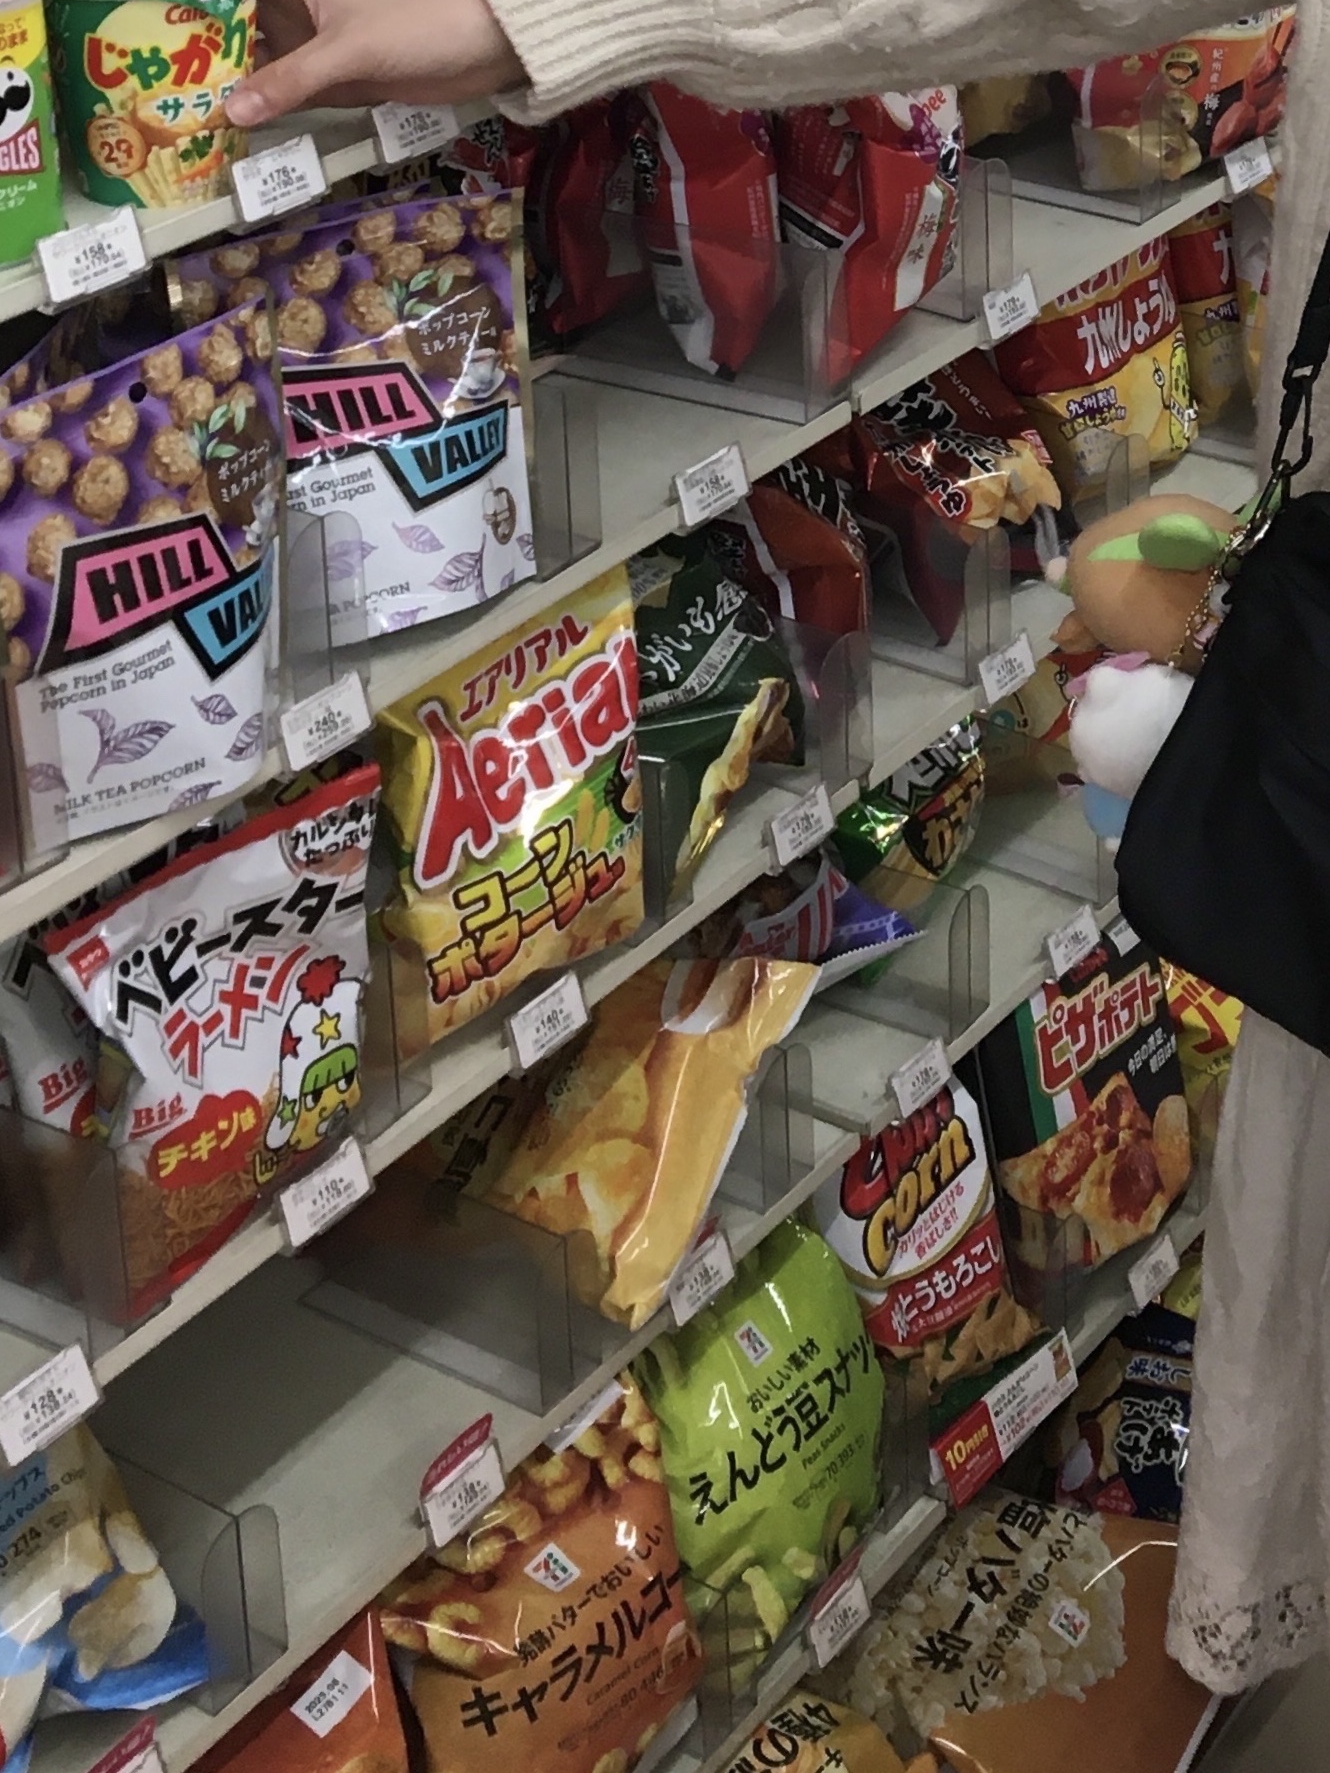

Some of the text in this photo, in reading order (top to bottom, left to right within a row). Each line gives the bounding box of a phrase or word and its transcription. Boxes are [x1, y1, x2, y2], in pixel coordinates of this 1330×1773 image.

[99, 138, 134, 164] 29
[285, 380, 416, 444] HILL
[309, 465, 375, 495] Gourmet
[408, 416, 506, 486] VALLEY
[330, 480, 377, 504] Japan
[86, 525, 226, 619] HILL
[39, 640, 174, 701] The First Gourmet
[40, 684, 108, 715] Popcorn
[130, 657, 177, 691] Japan
[459, 613, 589, 724] エアリアル
[53, 757, 207, 817] MILK TEA POPCORN
[418, 635, 639, 884] Aerial
[453, 818, 574, 935] コーン
[112, 876, 366, 1027] ベビースター
[430, 854, 627, 1004] ポタージュ
[162, 942, 312, 1079] ラーメン
[1034, 964, 1163, 1092] ピザポテト
[40, 1057, 89, 1102] Big
[132, 1091, 185, 1134] Big
[158, 1104, 257, 1179] チキン味
[745, 1336, 822, 1417] おいしい素材
[12, 1524, 43, 1557] 274
[586, 1645, 660, 1707] Caramel Corn
